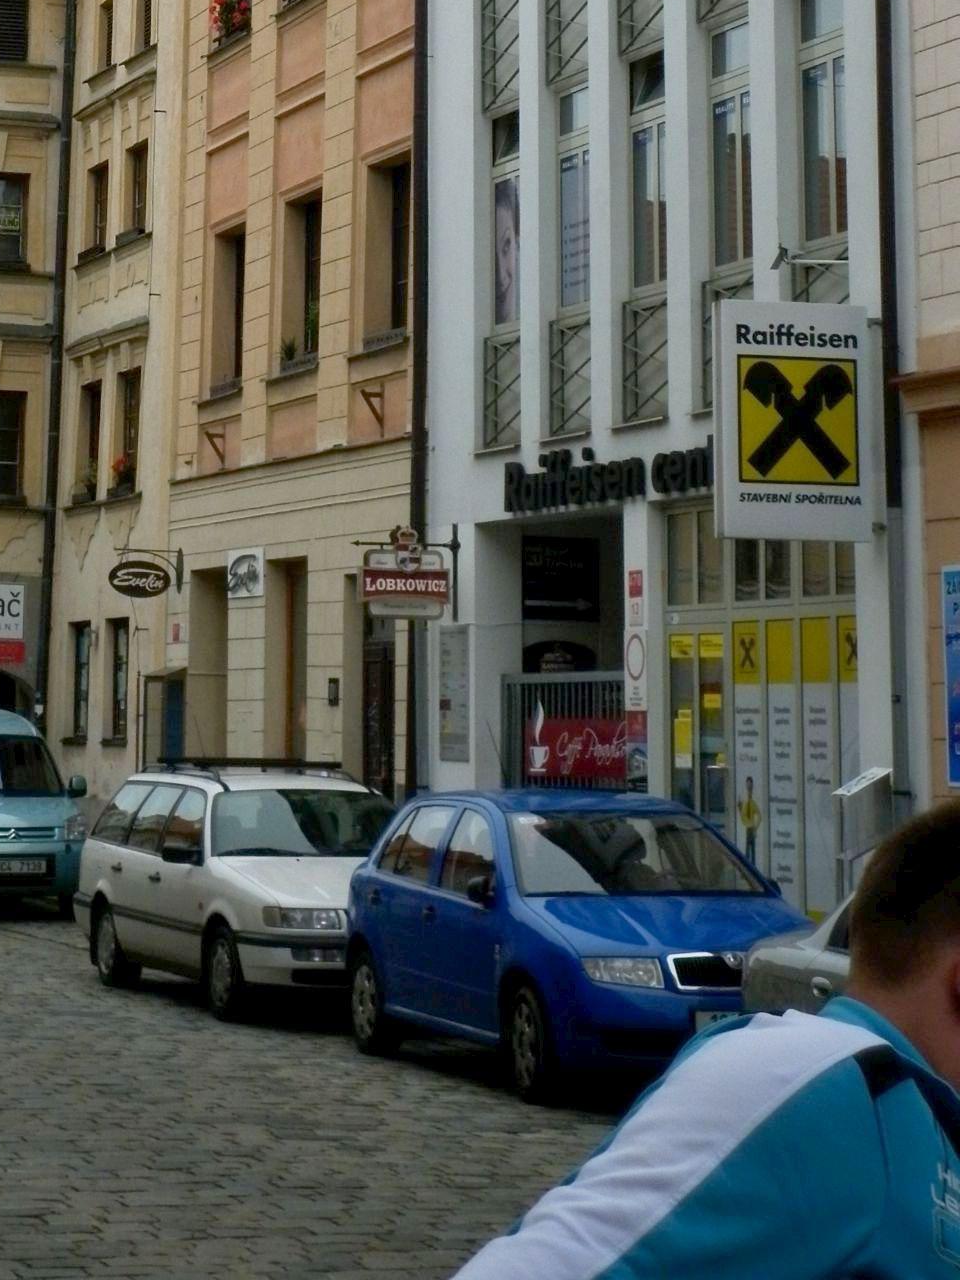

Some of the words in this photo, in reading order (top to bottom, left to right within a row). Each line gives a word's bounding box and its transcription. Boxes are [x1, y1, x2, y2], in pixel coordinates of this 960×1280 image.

[736, 323, 858, 349] Raiffeisen
[504, 447, 646, 513] Raiffeisen
[739, 491, 792, 504] STAVEBNÍ
[795, 492, 862, 506] SPOŘITELNA
[112, 568, 165, 592] Evelin
[365, 577, 447, 592] LOBKOWICZ
